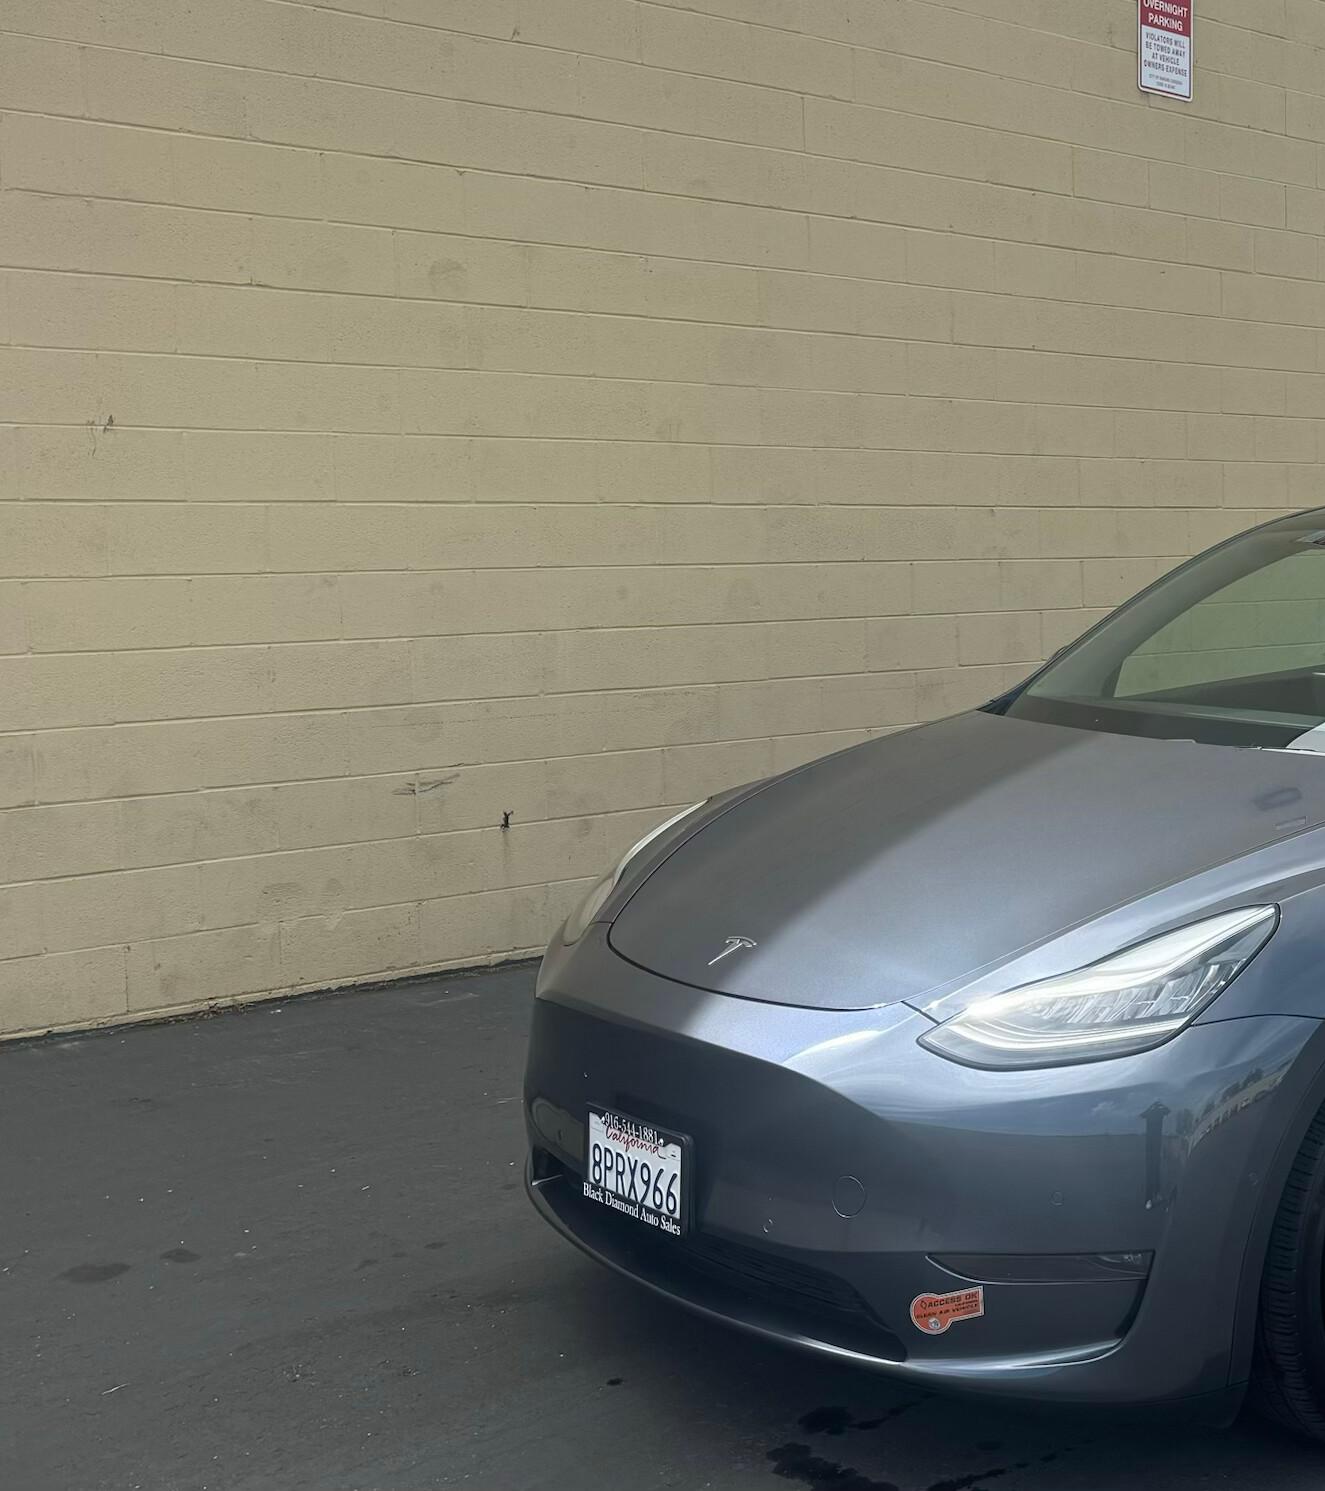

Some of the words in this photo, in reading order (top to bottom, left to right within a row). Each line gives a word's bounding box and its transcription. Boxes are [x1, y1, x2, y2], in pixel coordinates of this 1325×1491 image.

[1143, 0, 1188, 17] OVERNIGHT
[1148, 13, 1183, 31] PARKING
[1145, 32, 1173, 46] VIOLATORS
[1174, 39, 1185, 49] WILL
[1145, 41, 1152, 50] BE
[1153, 43, 1170, 54] TOWED
[1172, 48, 1185, 57] AWAY
[1152, 52, 1158, 60] AT
[1159, 54, 1179, 65] VEHICLE
[1143, 59, 1165, 71] OWNERS
[1166, 65, 1187, 77] EXPENSE
[604, 1112, 658, 1145] 916-544-1881
[592, 1143, 678, 1215] 8PRX966
[583, 1182, 604, 1203] Black
[605, 1191, 639, 1218] Diamond
[640, 1208, 659, 1227] Auto
[660, 1215, 681, 1236] Sales
[927, 1295, 962, 1308] ACCESS
[964, 1291, 978, 1301] OK
